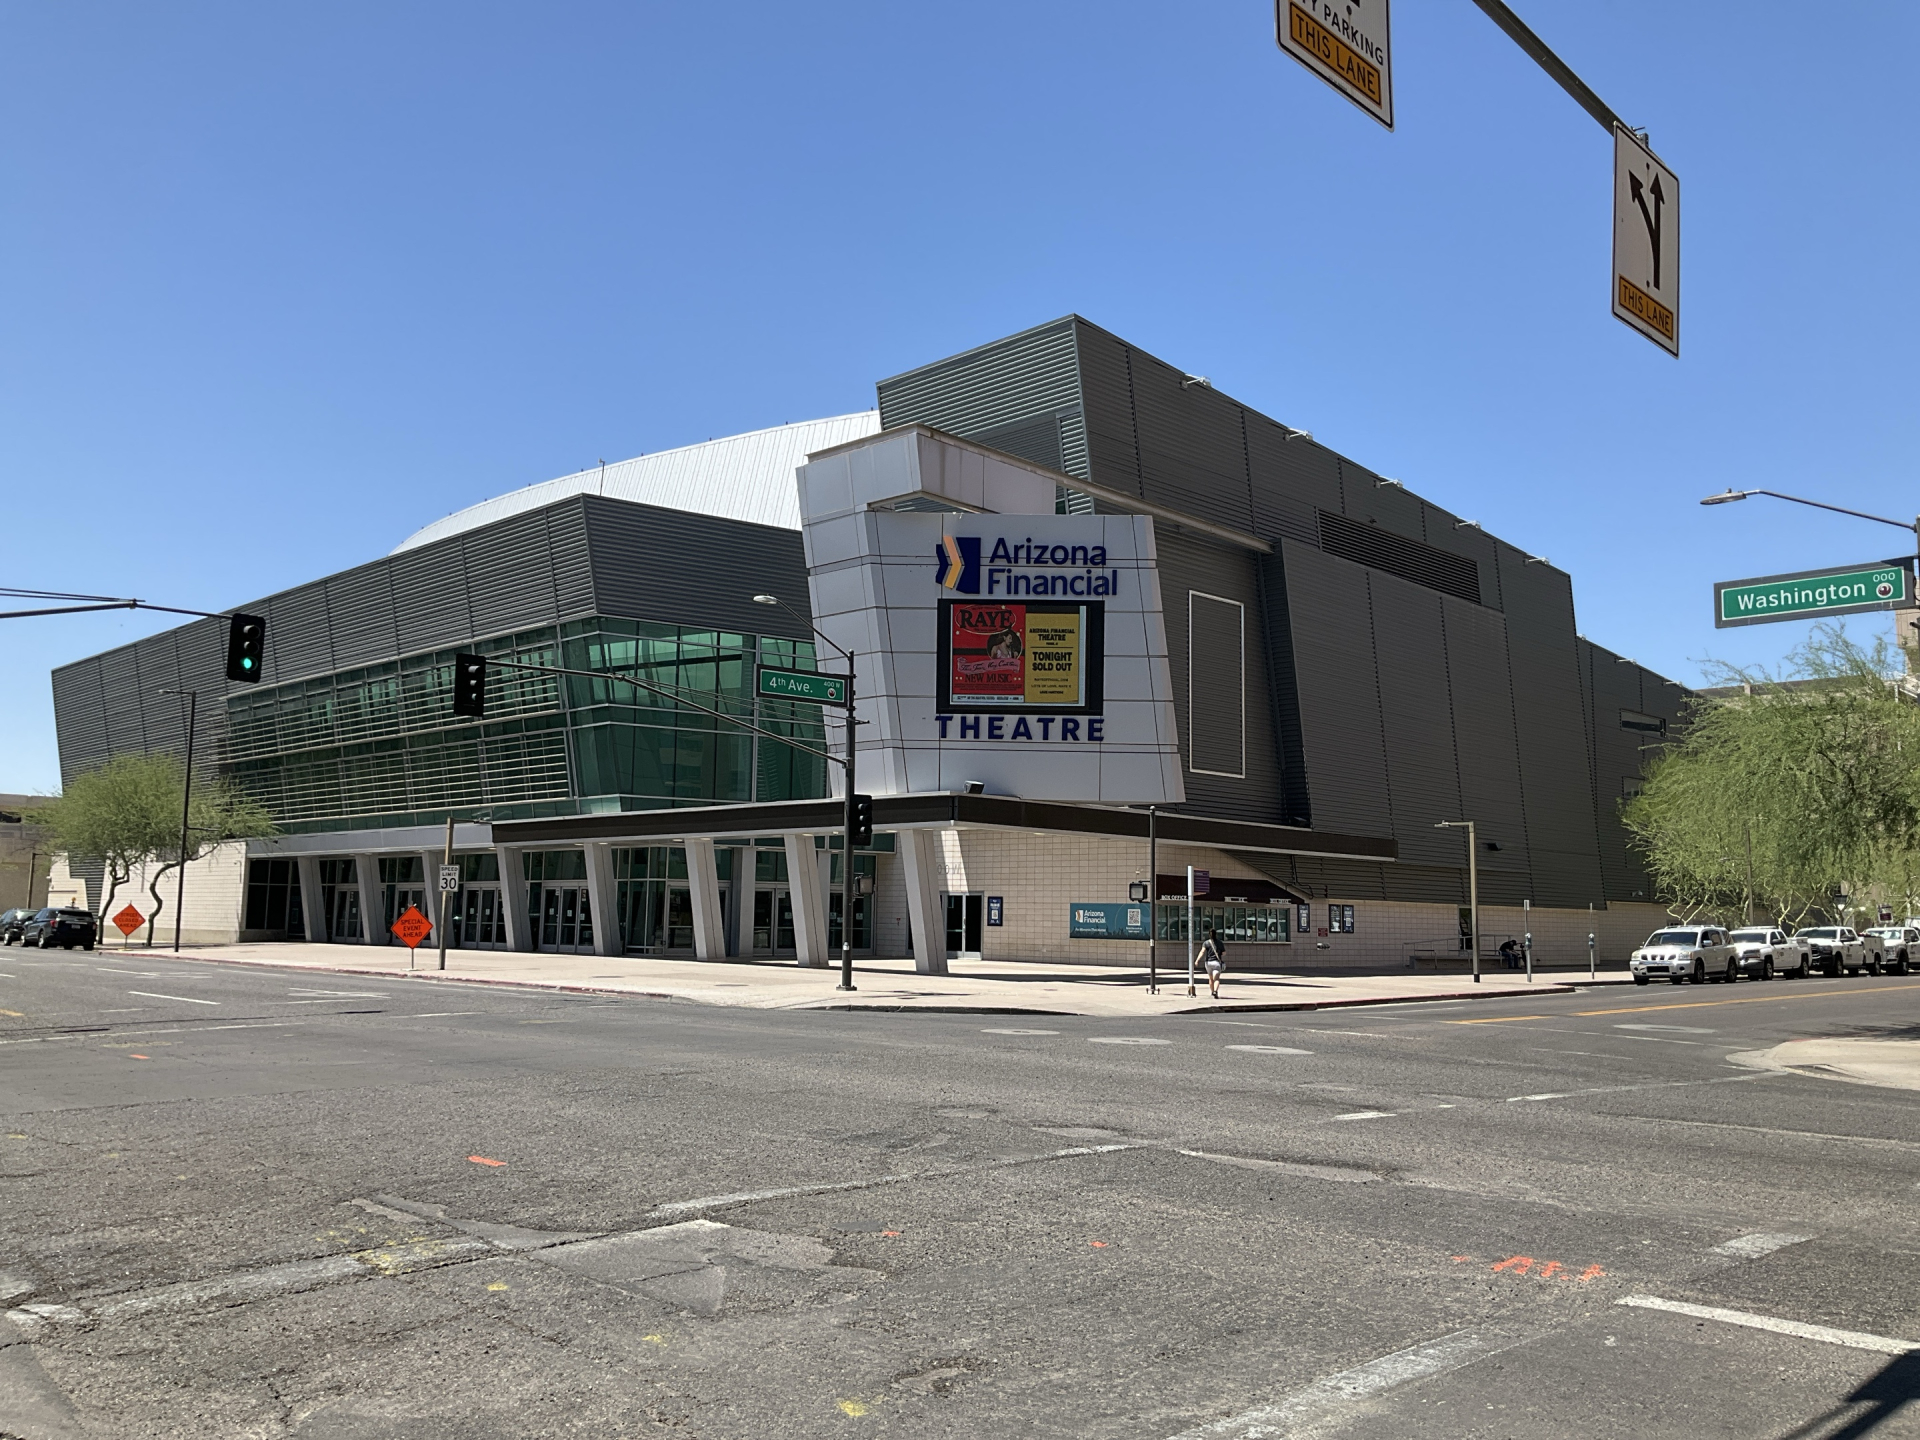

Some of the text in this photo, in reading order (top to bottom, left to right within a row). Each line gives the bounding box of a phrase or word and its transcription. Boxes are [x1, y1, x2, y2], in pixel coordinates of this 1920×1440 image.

[1324, 4, 1384, 66] PARKING
[1296, 13, 1376, 95] THIS LANE
[1623, 284, 1670, 333] THIS LANE
[989, 537, 1107, 566] Arizona
[987, 568, 1118, 596] Financial
[1737, 583, 1867, 611] Washington
[960, 610, 1012, 629] RAYE
[1032, 652, 1072, 662] TONIGHT
[1032, 663, 1072, 671] SOLD OUT
[769, 676, 813, 693] 4th Ave.
[965, 673, 1013, 683] NEW MUSIC
[935, 715, 1105, 742] THEATRE
[441, 877, 457, 889] 30
